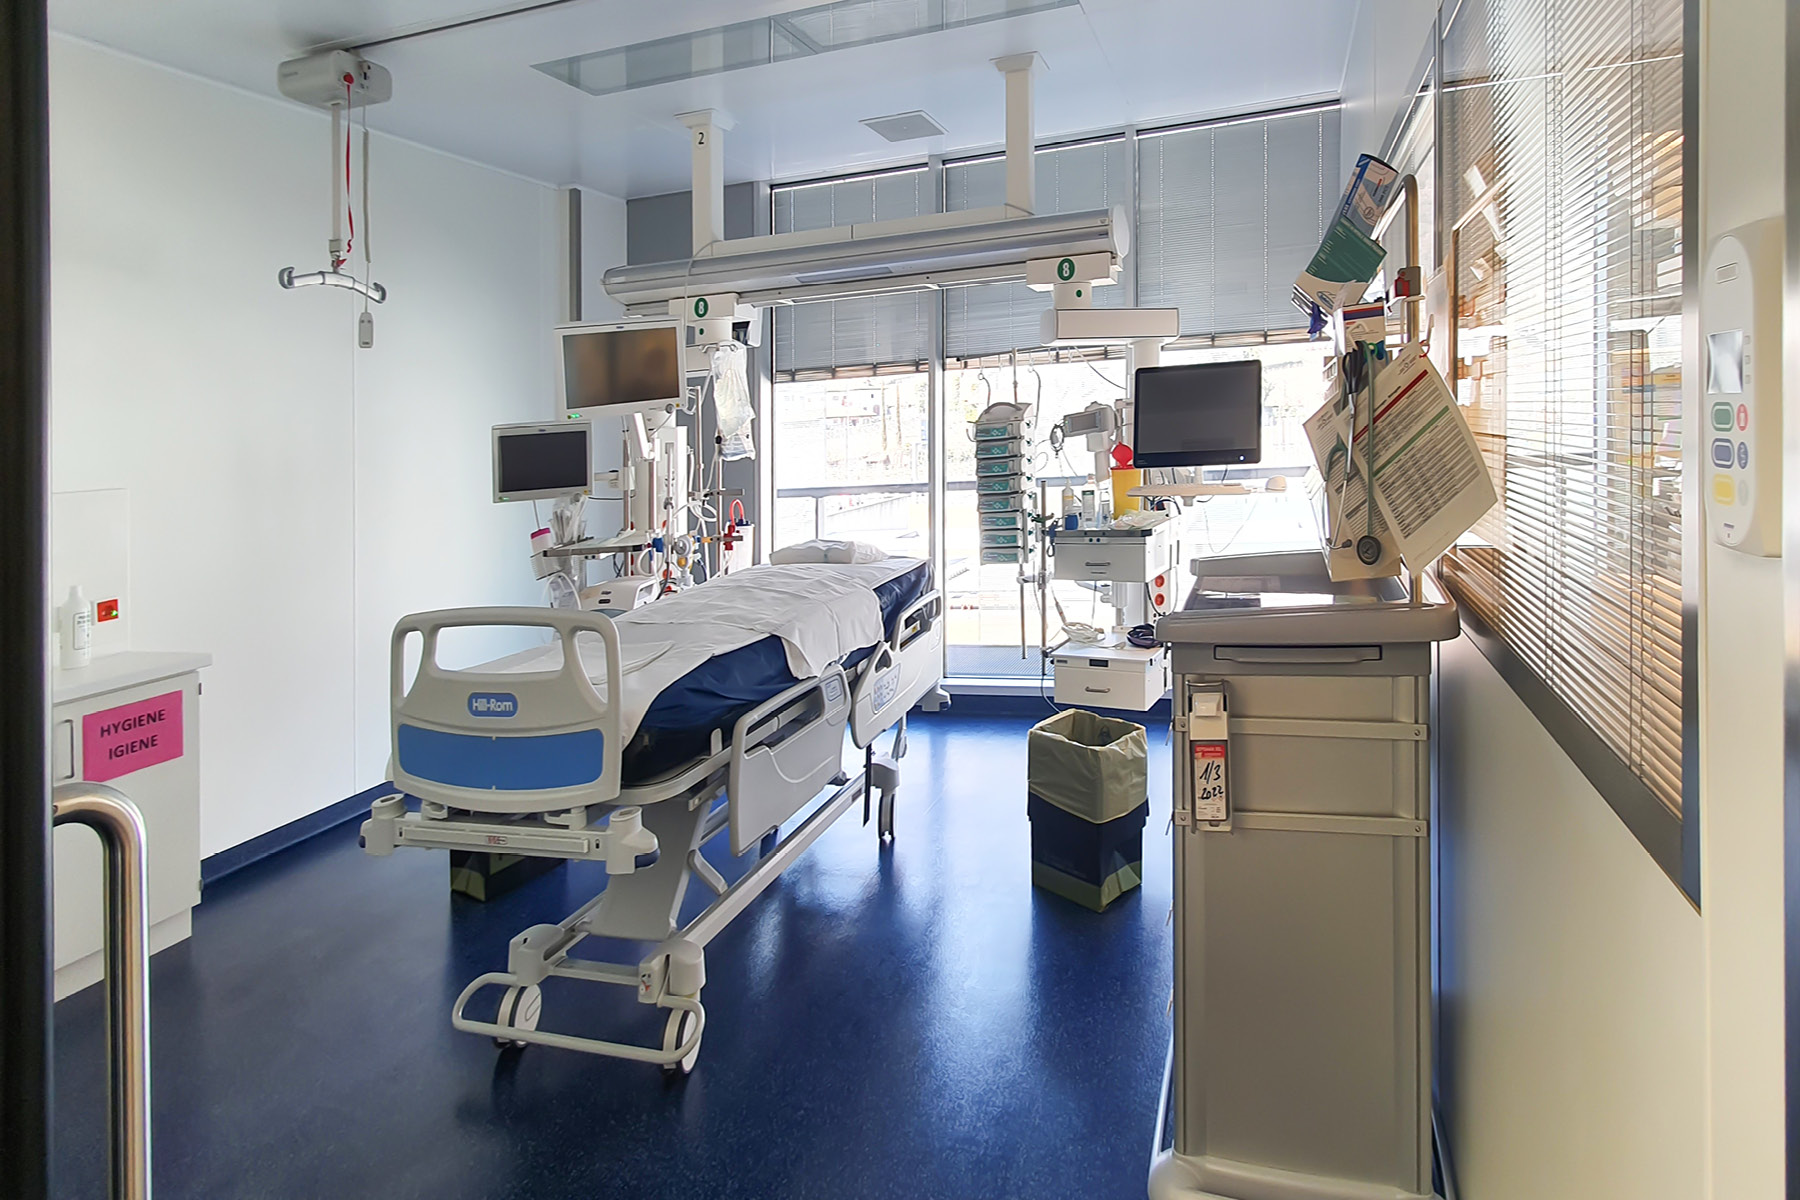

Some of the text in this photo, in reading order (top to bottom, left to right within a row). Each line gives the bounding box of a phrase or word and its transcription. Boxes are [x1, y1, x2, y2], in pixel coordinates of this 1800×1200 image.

[698, 132, 705, 145] 2
[1062, 262, 1070, 277] 8
[698, 301, 705, 315] 8
[472, 698, 513, 711] H-Rom
[100, 709, 166, 738] HYGIENE
[108, 735, 158, 760] IGIENE
[1199, 760, 1221, 784] 1/3
[1200, 785, 1224, 800] 2022
